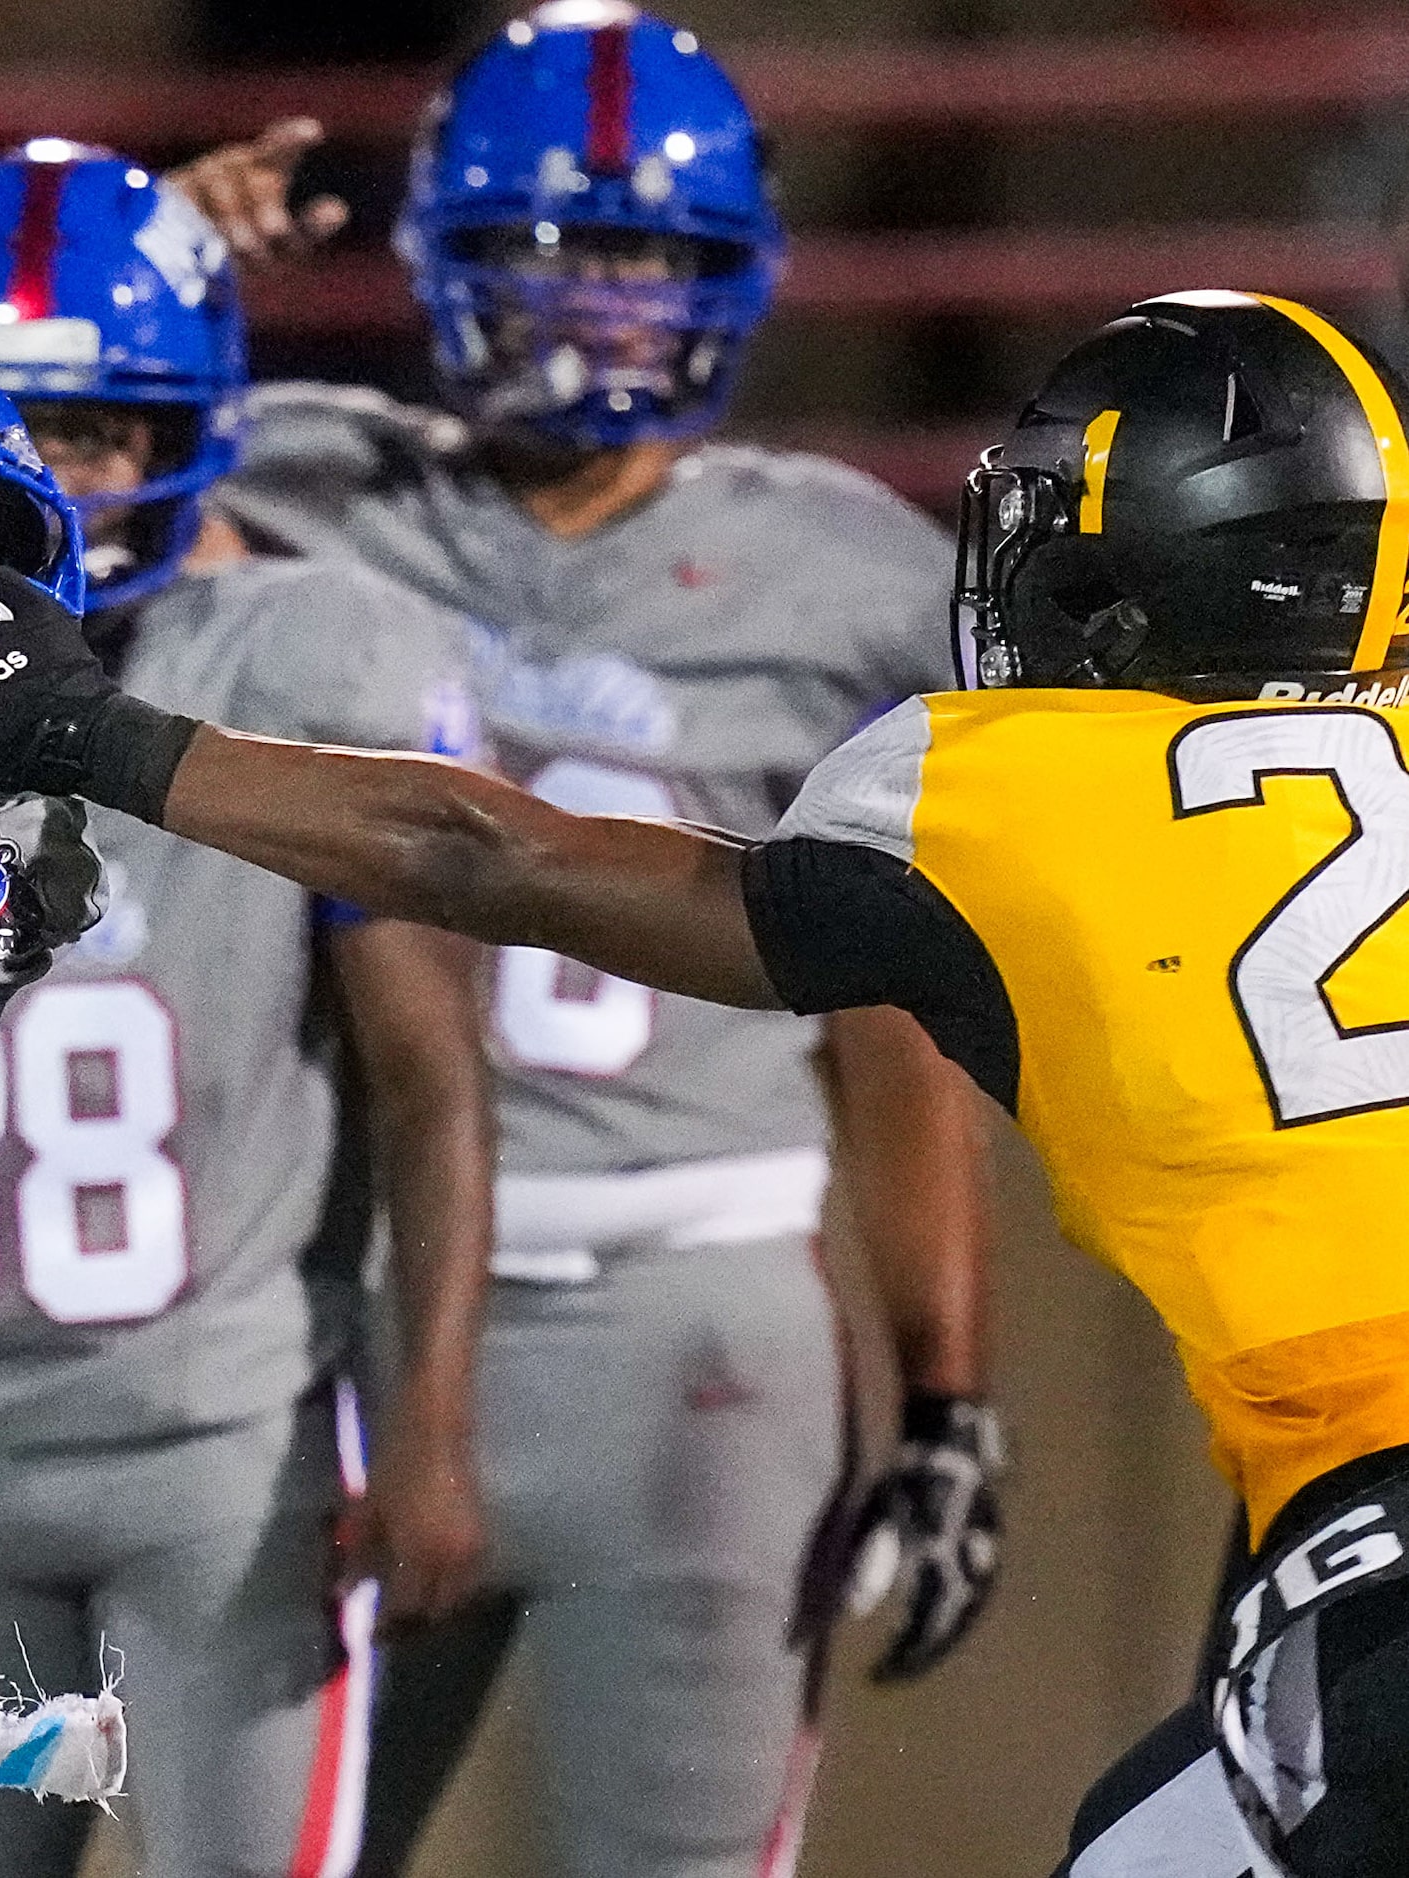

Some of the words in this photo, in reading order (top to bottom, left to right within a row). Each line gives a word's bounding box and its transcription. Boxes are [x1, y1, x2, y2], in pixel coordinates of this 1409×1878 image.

[1078, 409, 1122, 535] 1
[1250, 579, 1301, 597] Riddell
[1171, 706, 1409, 1130] 2
